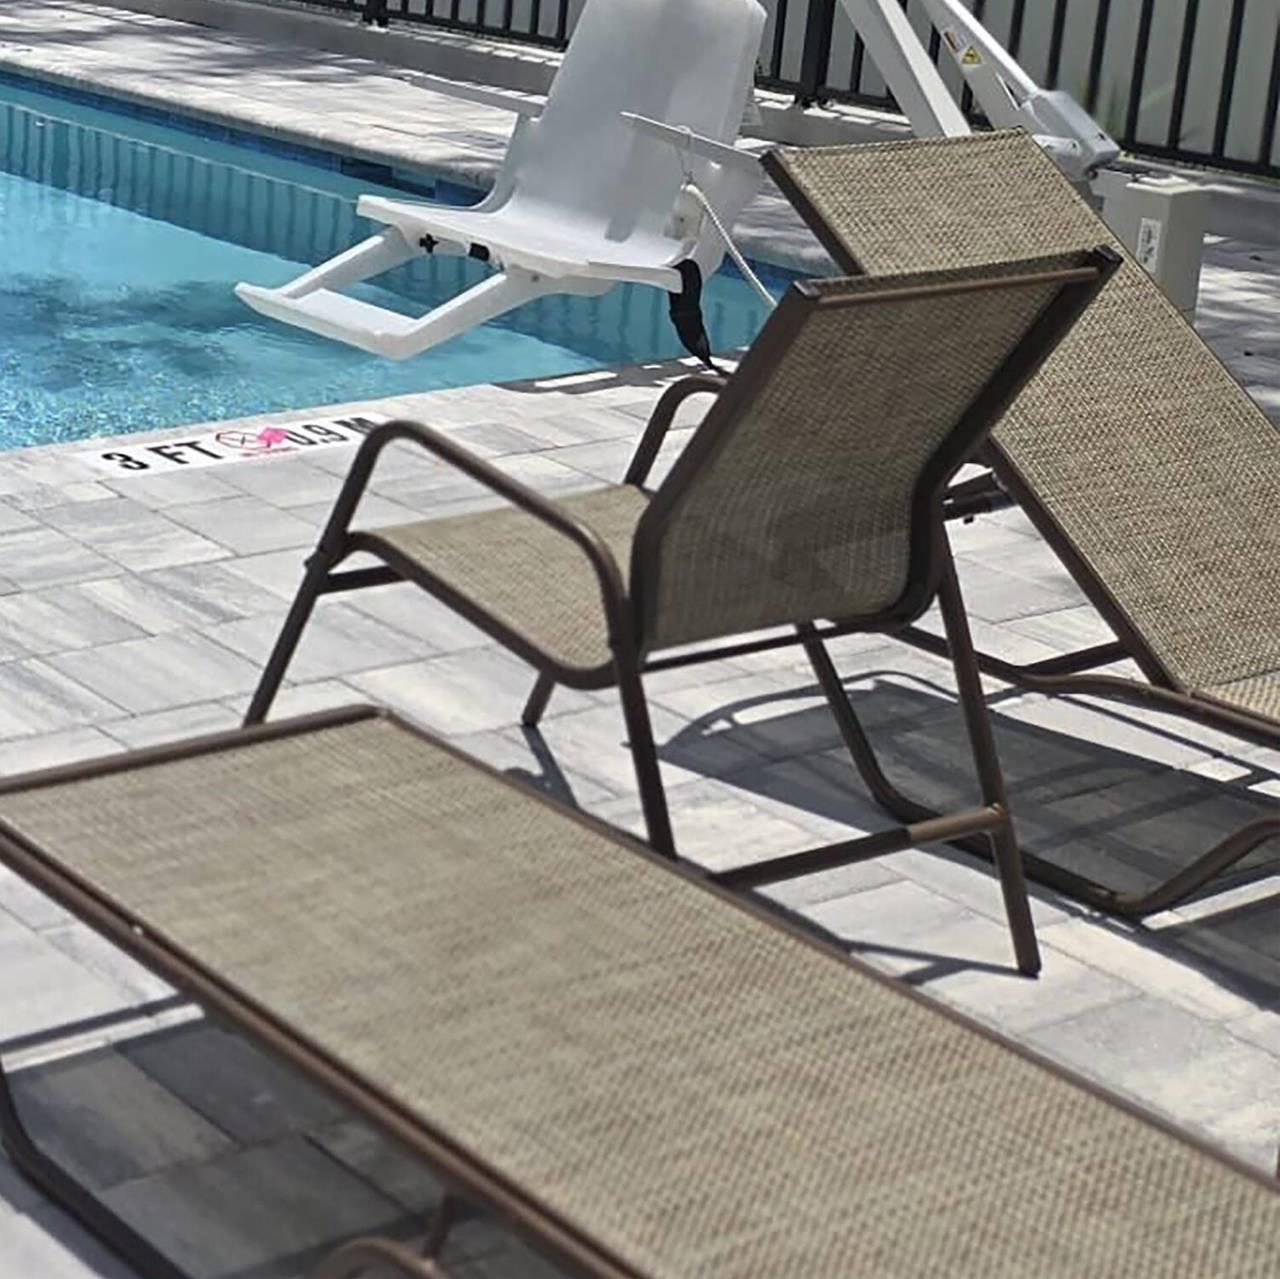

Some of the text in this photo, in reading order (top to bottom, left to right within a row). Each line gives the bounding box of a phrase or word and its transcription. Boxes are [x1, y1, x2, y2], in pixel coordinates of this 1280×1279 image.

[284, 424, 349, 446] 0.9
[101, 452, 150, 470] 3
[146, 441, 224, 464] FT
